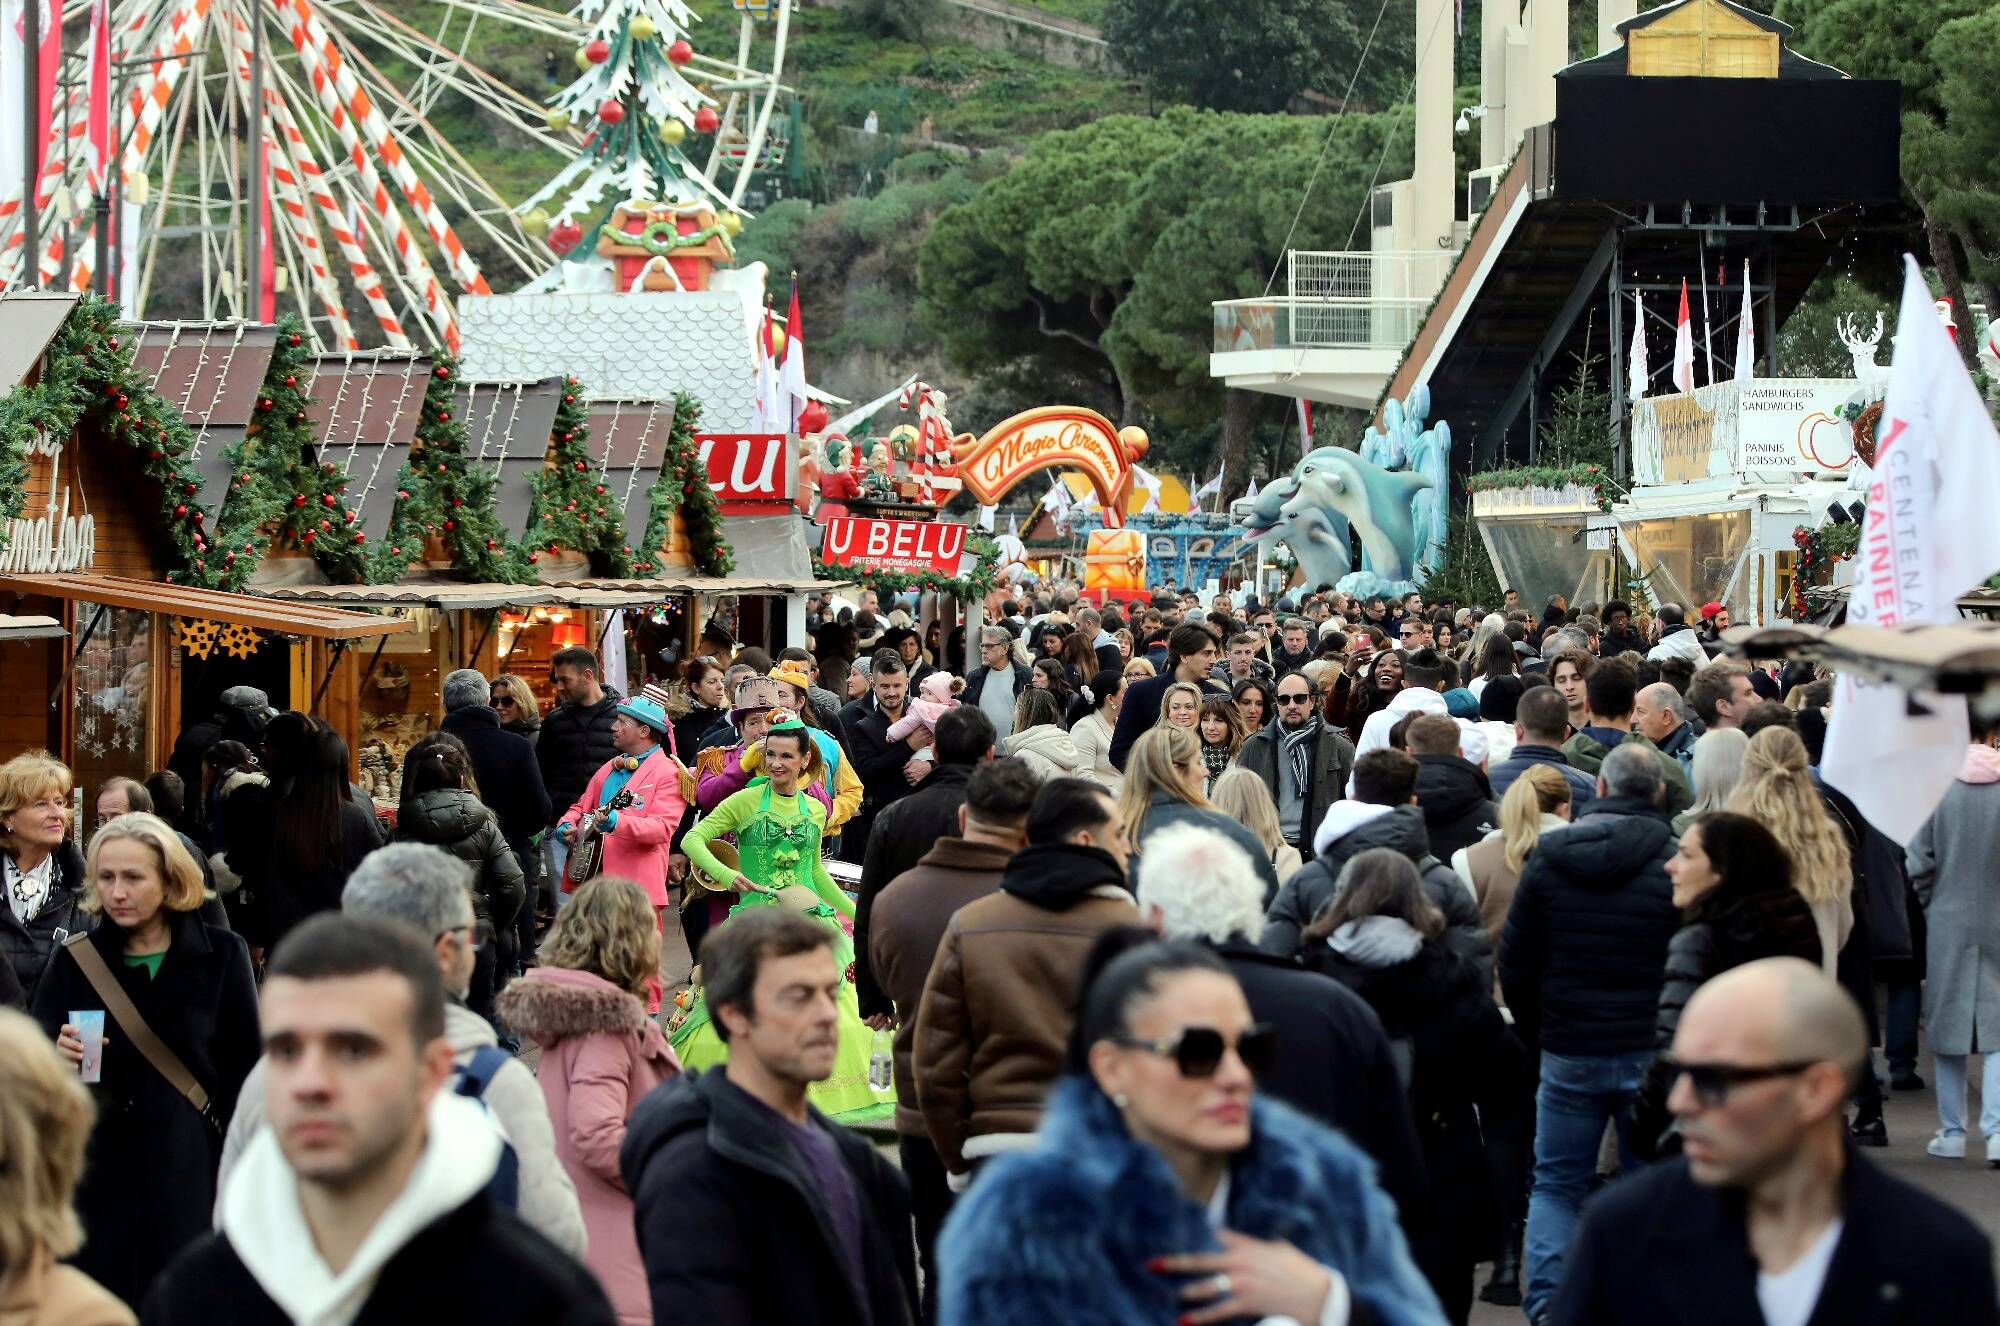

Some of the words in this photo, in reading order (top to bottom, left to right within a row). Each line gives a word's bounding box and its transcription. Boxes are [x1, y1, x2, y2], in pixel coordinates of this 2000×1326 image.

[1743, 388, 1814, 398] HAMBURGERS
[1742, 401, 1804, 411] SANDWICHS
[984, 430, 1056, 482] Magic
[1058, 422, 1116, 480] Christmas
[1745, 443, 1785, 452] PANINIS
[1745, 455, 1797, 465] BOISSONS
[829, 519, 855, 554] U
[866, 521, 963, 559] BELU
[850, 555, 882, 565] FRITERIE
